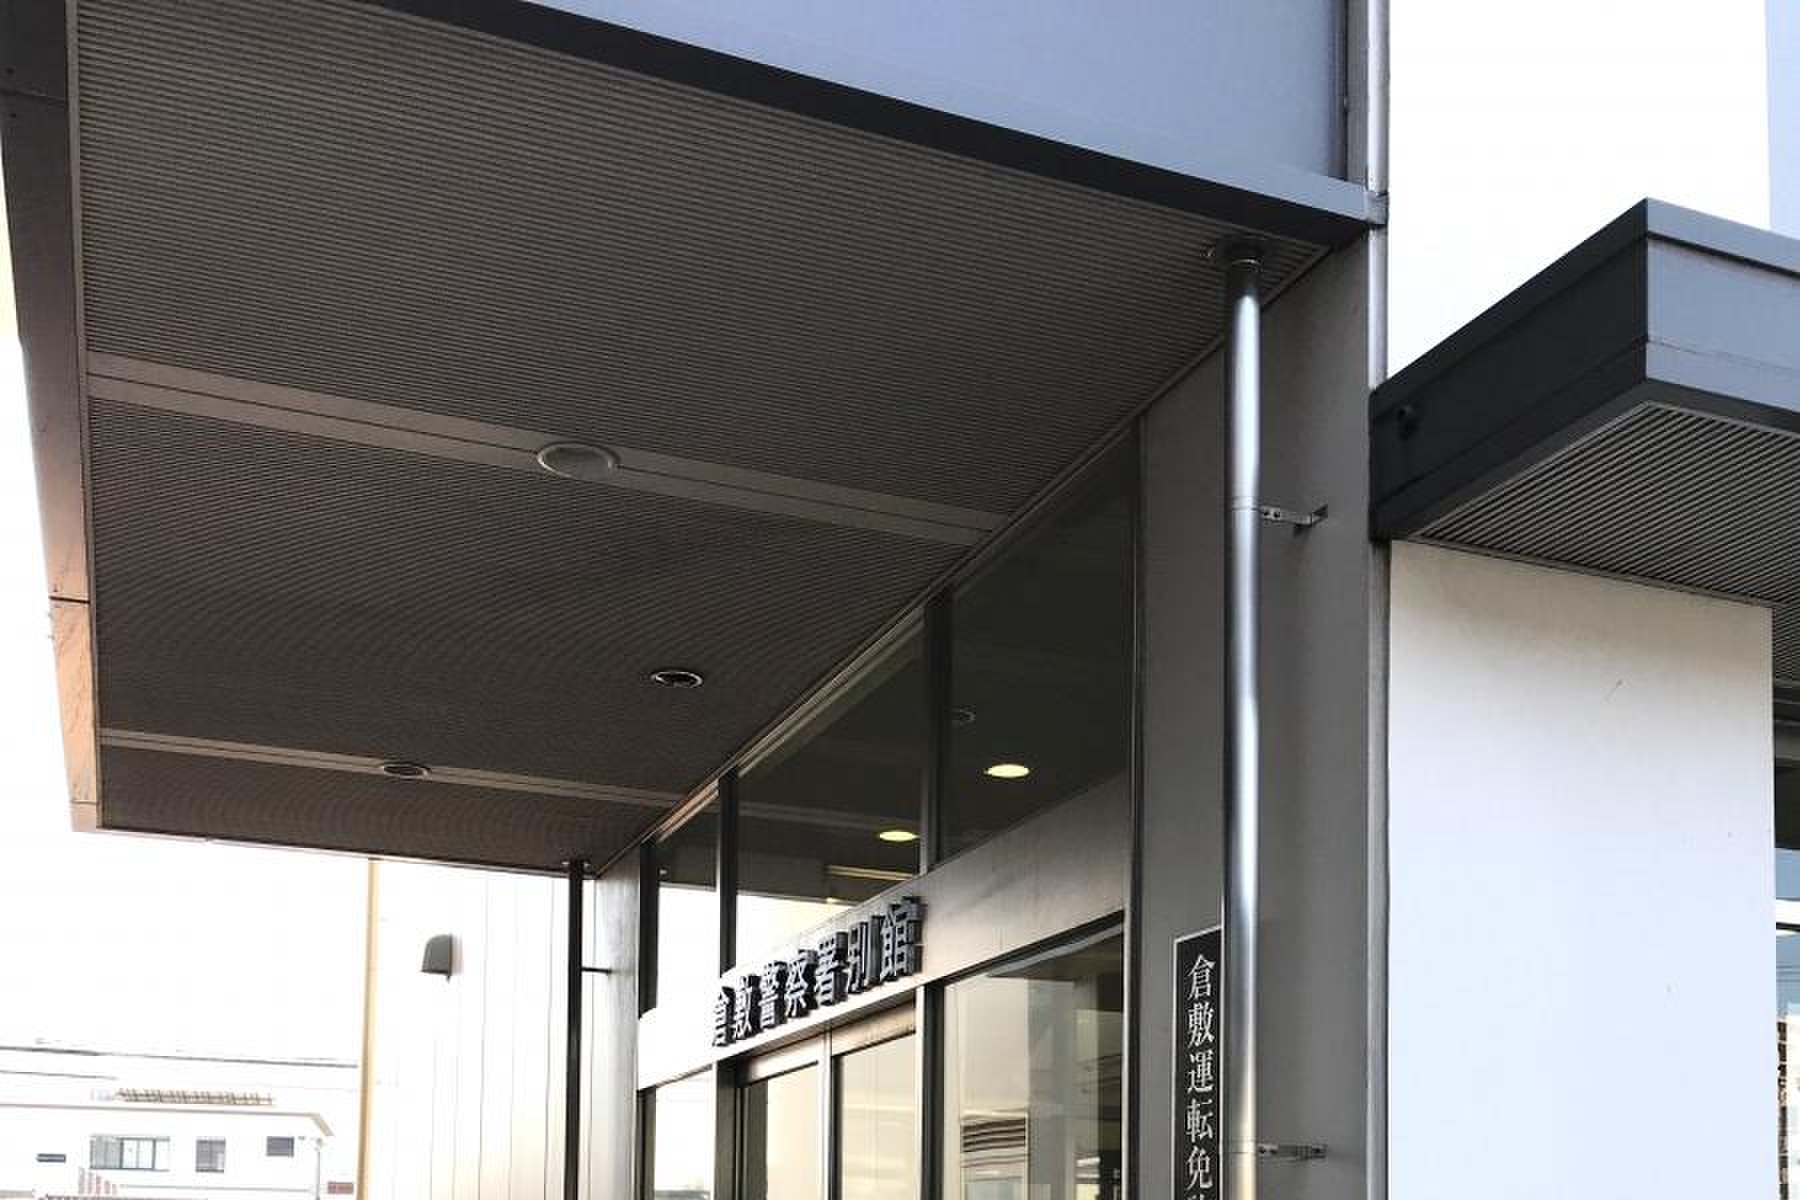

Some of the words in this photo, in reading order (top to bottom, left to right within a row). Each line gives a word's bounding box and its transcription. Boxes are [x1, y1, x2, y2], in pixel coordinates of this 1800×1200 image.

[712, 896, 926, 1047] 倉敷警察署別館
